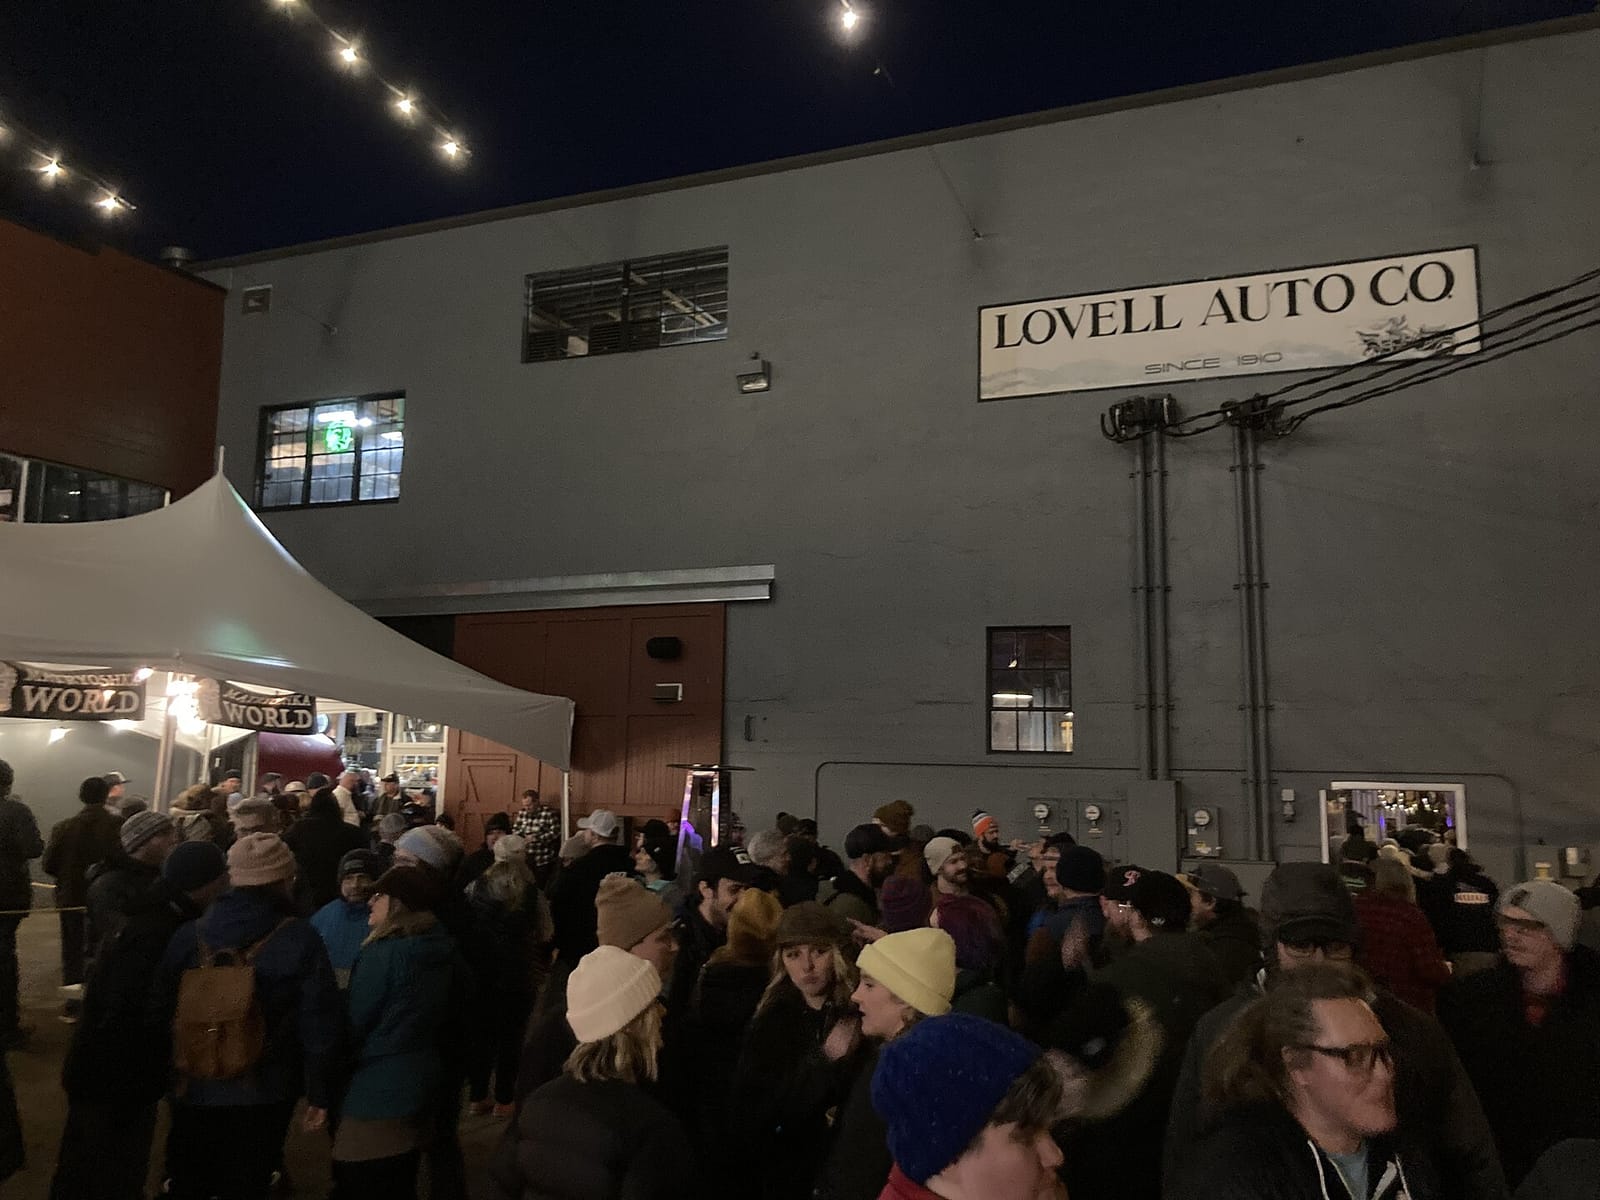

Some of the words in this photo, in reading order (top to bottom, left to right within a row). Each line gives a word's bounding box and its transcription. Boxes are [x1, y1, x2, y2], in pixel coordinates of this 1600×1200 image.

[993, 294, 1182, 349] LOVELL
[1201, 273, 1356, 326] AUTO
[1144, 356, 1221, 375] SINCE
[1236, 351, 1283, 366] 1910
[21, 685, 140, 713] WORLD
[222, 700, 313, 729] WORLD
